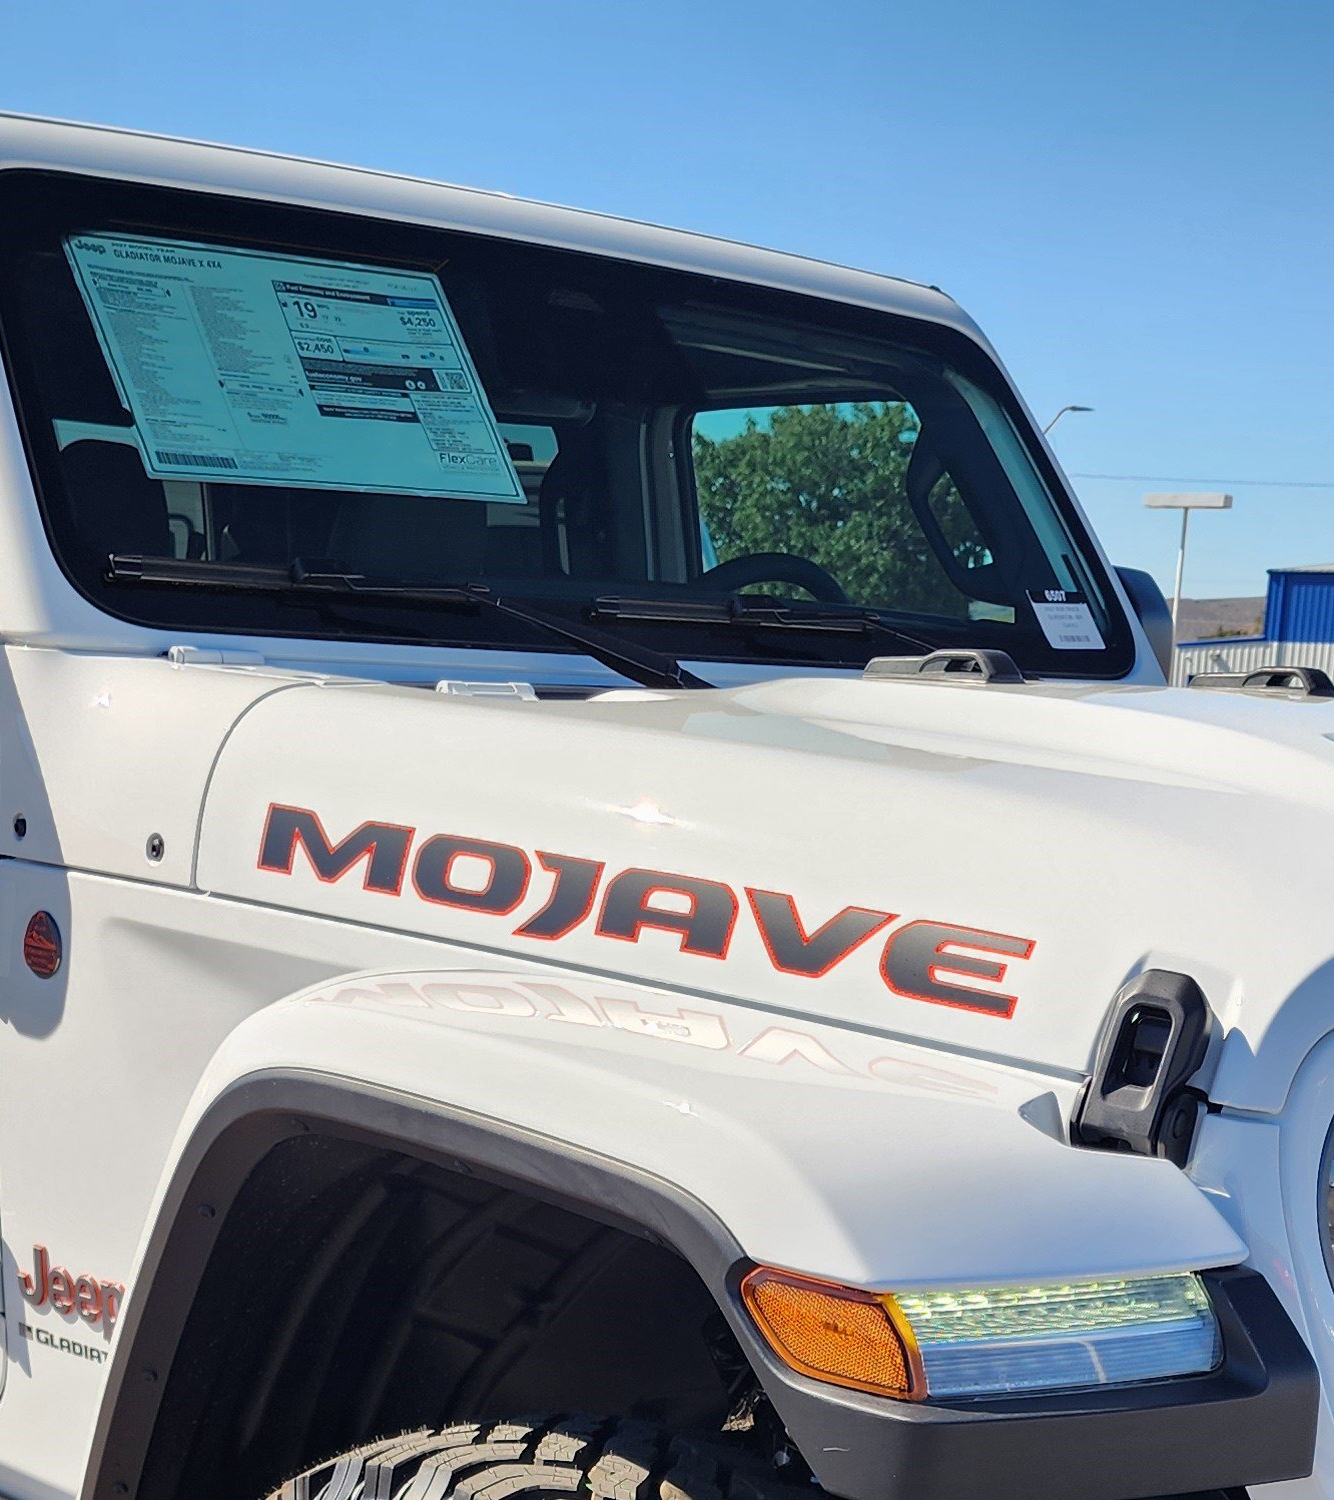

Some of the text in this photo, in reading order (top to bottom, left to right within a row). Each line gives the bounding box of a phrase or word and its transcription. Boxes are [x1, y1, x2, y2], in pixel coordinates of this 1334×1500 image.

[113, 249, 161, 263] GLADIATOR
[162, 254, 196, 268] MOJAVE
[293, 301, 317, 319] 19
[399, 316, 436, 328] $4,250
[296, 341, 334, 354] $2,450
[257, 802, 1037, 1020] MOJAVE
